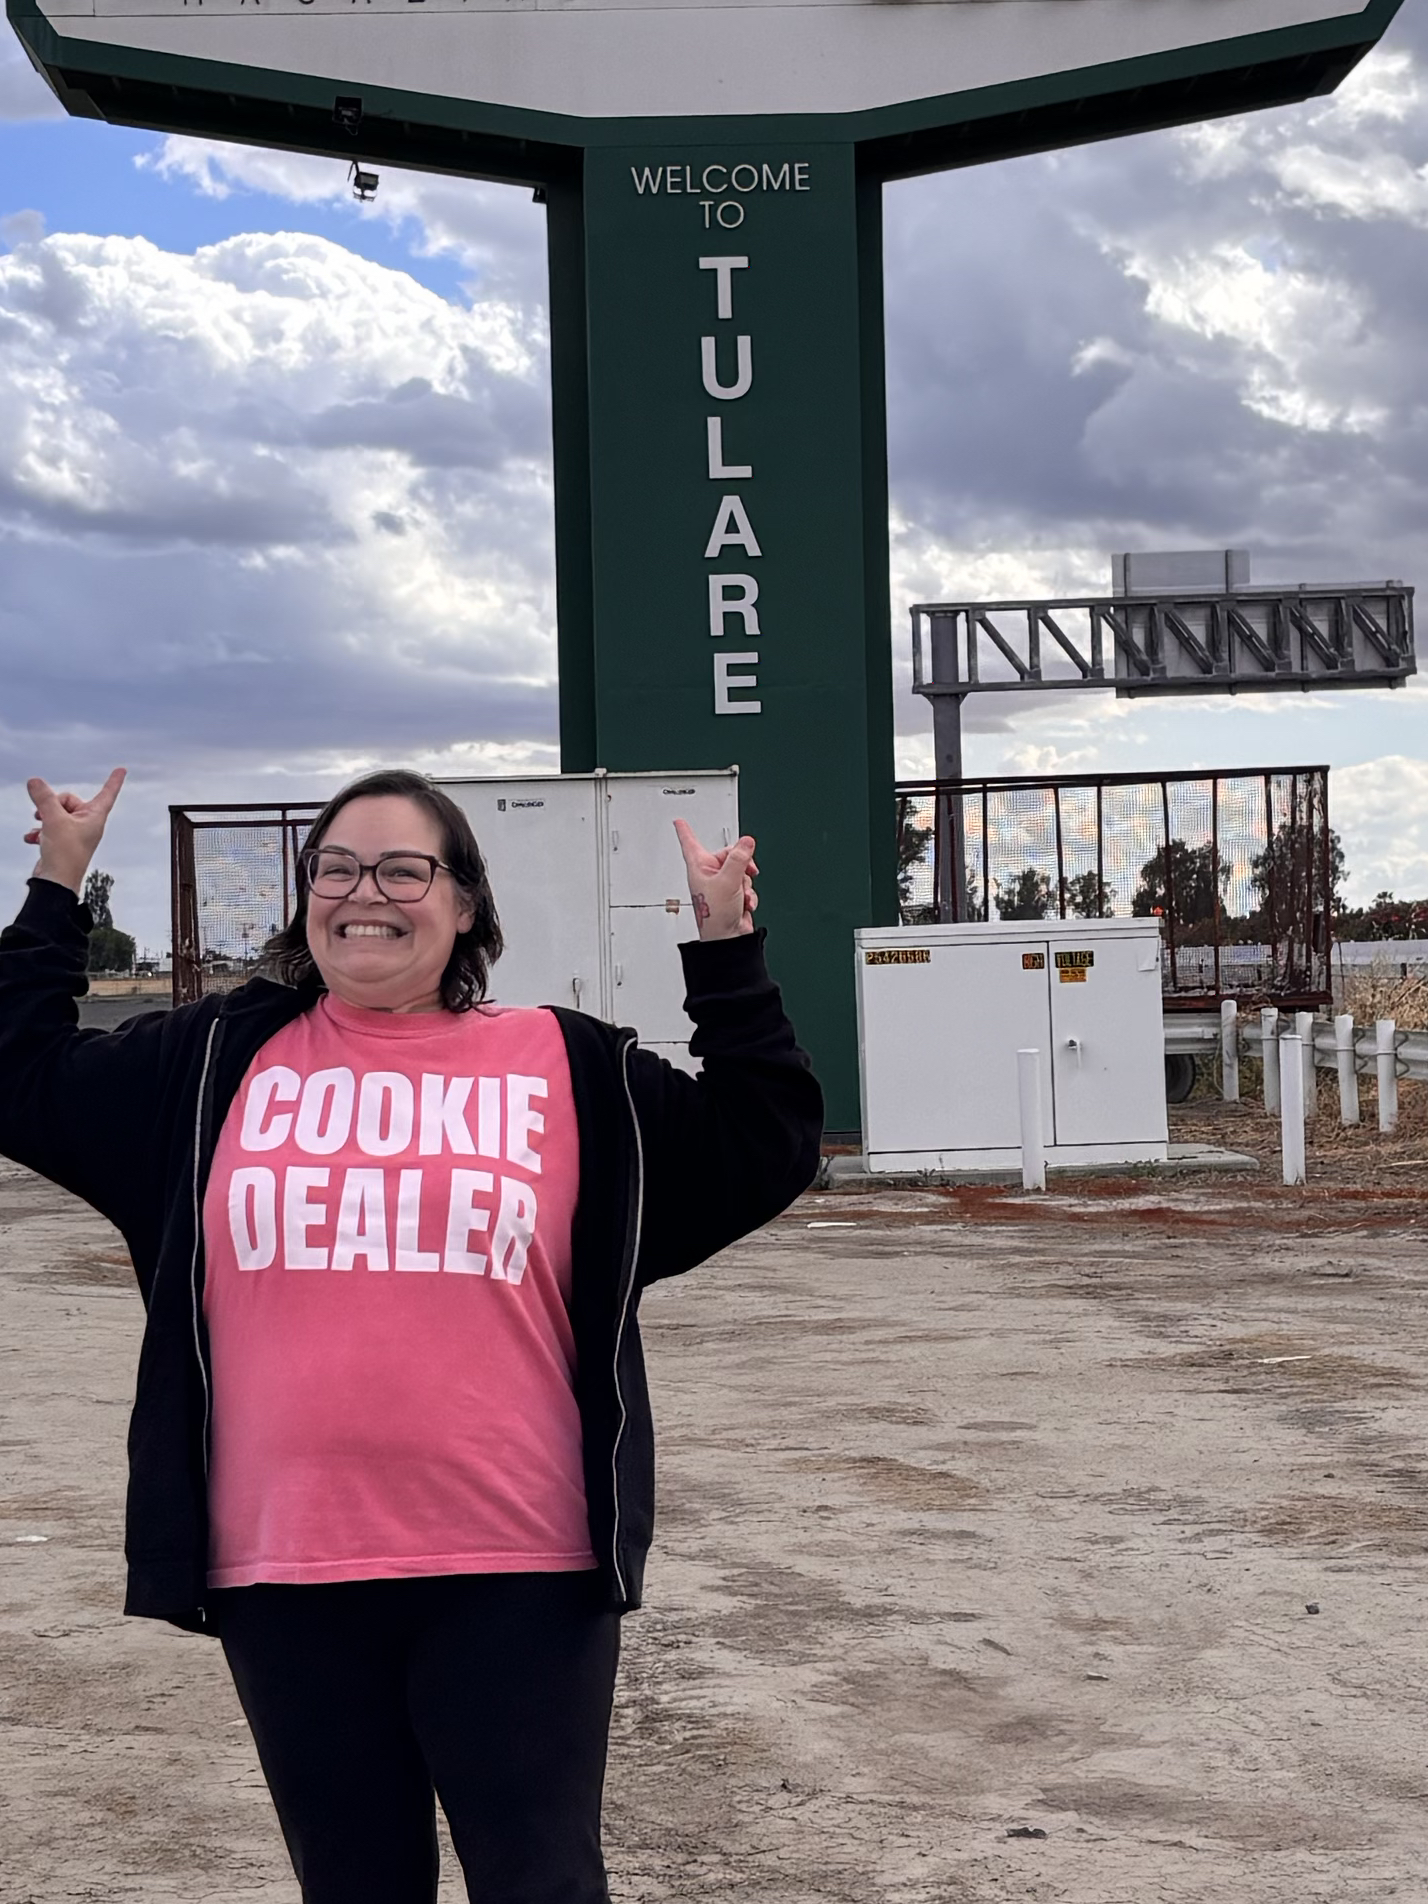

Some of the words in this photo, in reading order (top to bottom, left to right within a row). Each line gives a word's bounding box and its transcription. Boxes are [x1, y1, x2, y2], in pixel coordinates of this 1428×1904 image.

[630, 162, 812, 195] WELCOME
[698, 200, 746, 230] TO
[698, 255, 763, 716] TULARE
[239, 1065, 549, 1175] COOKIE
[227, 1166, 538, 1285] DEALER
